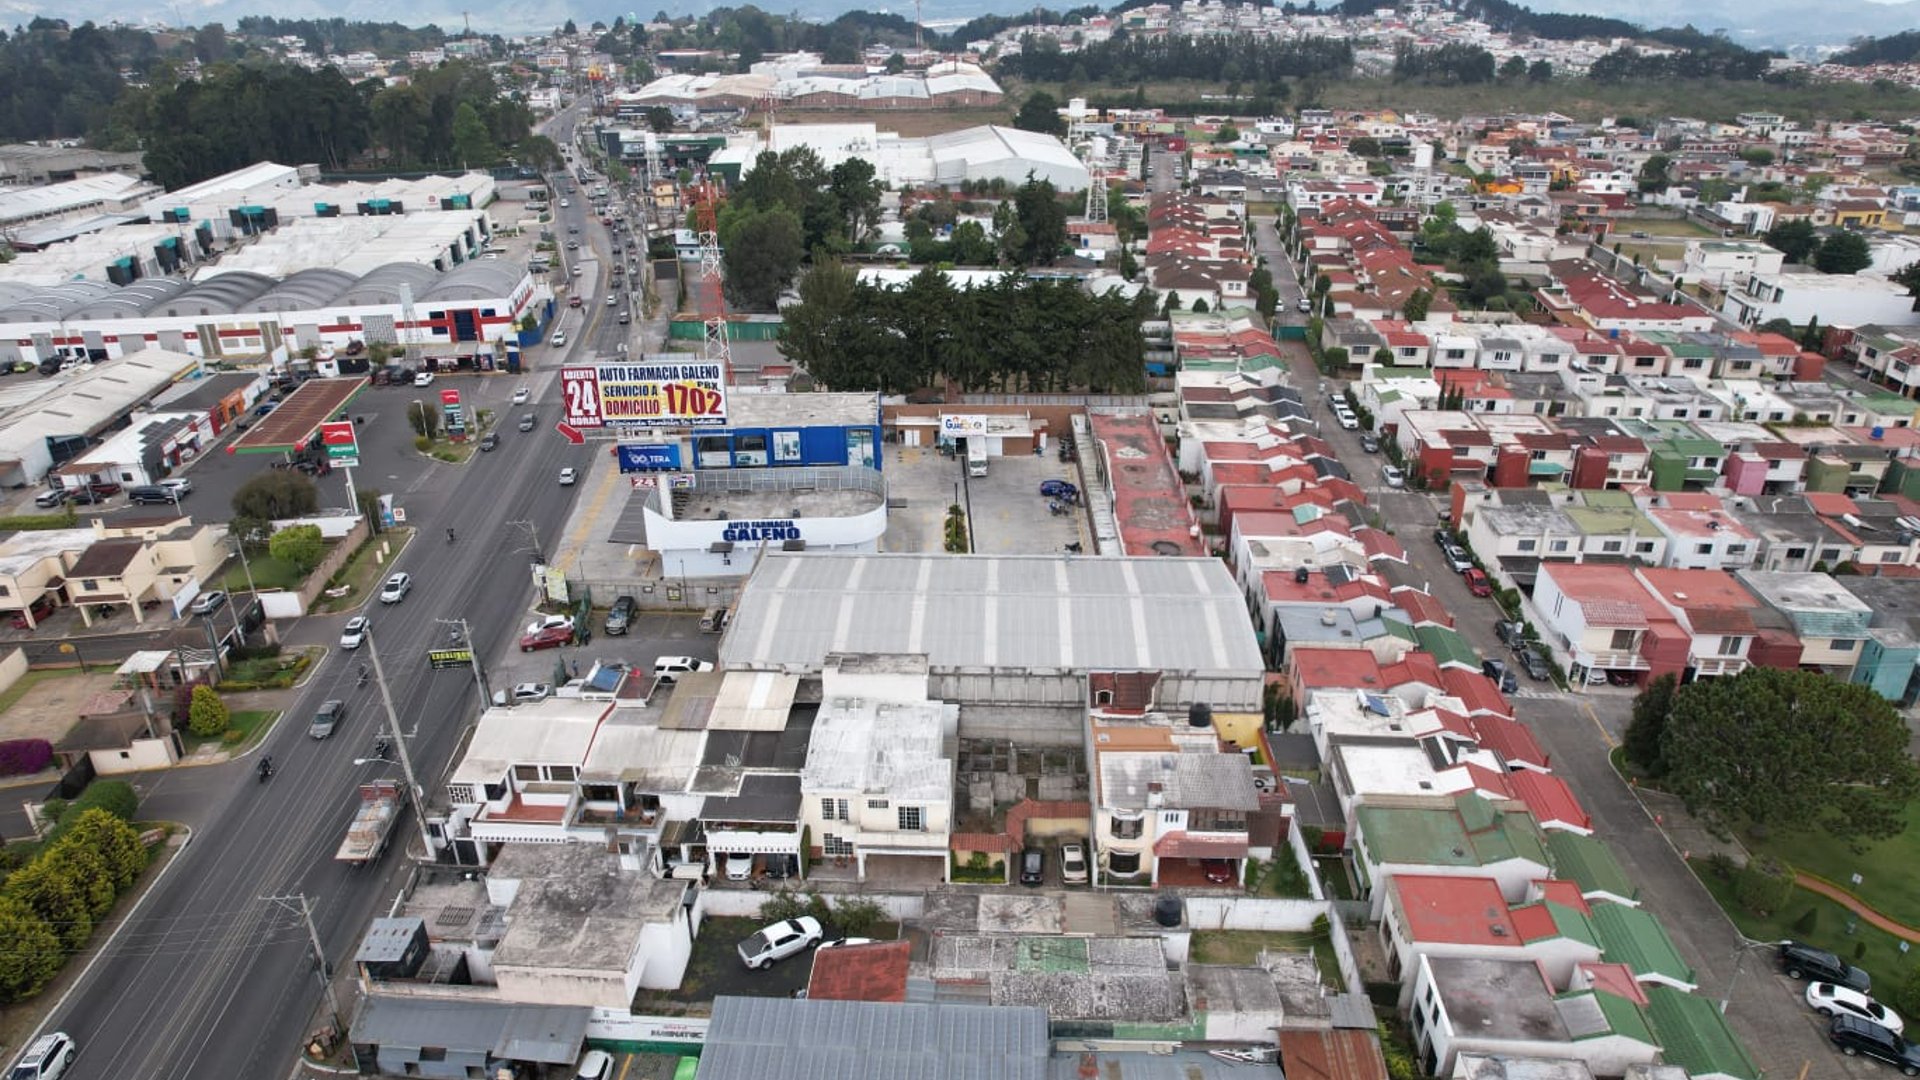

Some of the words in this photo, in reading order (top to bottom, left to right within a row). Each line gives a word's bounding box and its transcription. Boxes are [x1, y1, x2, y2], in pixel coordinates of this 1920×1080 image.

[564, 370, 594, 380] ABIERTO
[600, 367, 626, 381] AUTO
[628, 366, 678, 380] FARMACIA
[682, 365, 719, 379] GALENO
[604, 385, 649, 397] SERVICIO
[652, 385, 658, 396] A
[567, 380, 597, 416] 24
[662, 384, 723, 415] 1702
[606, 400, 660, 415] DOMICILIO
[570, 416, 600, 425] HORAS
[632, 477, 656, 487] 24
[751, 520, 794, 528] FARMACIA
[722, 527, 801, 541] GALENO
